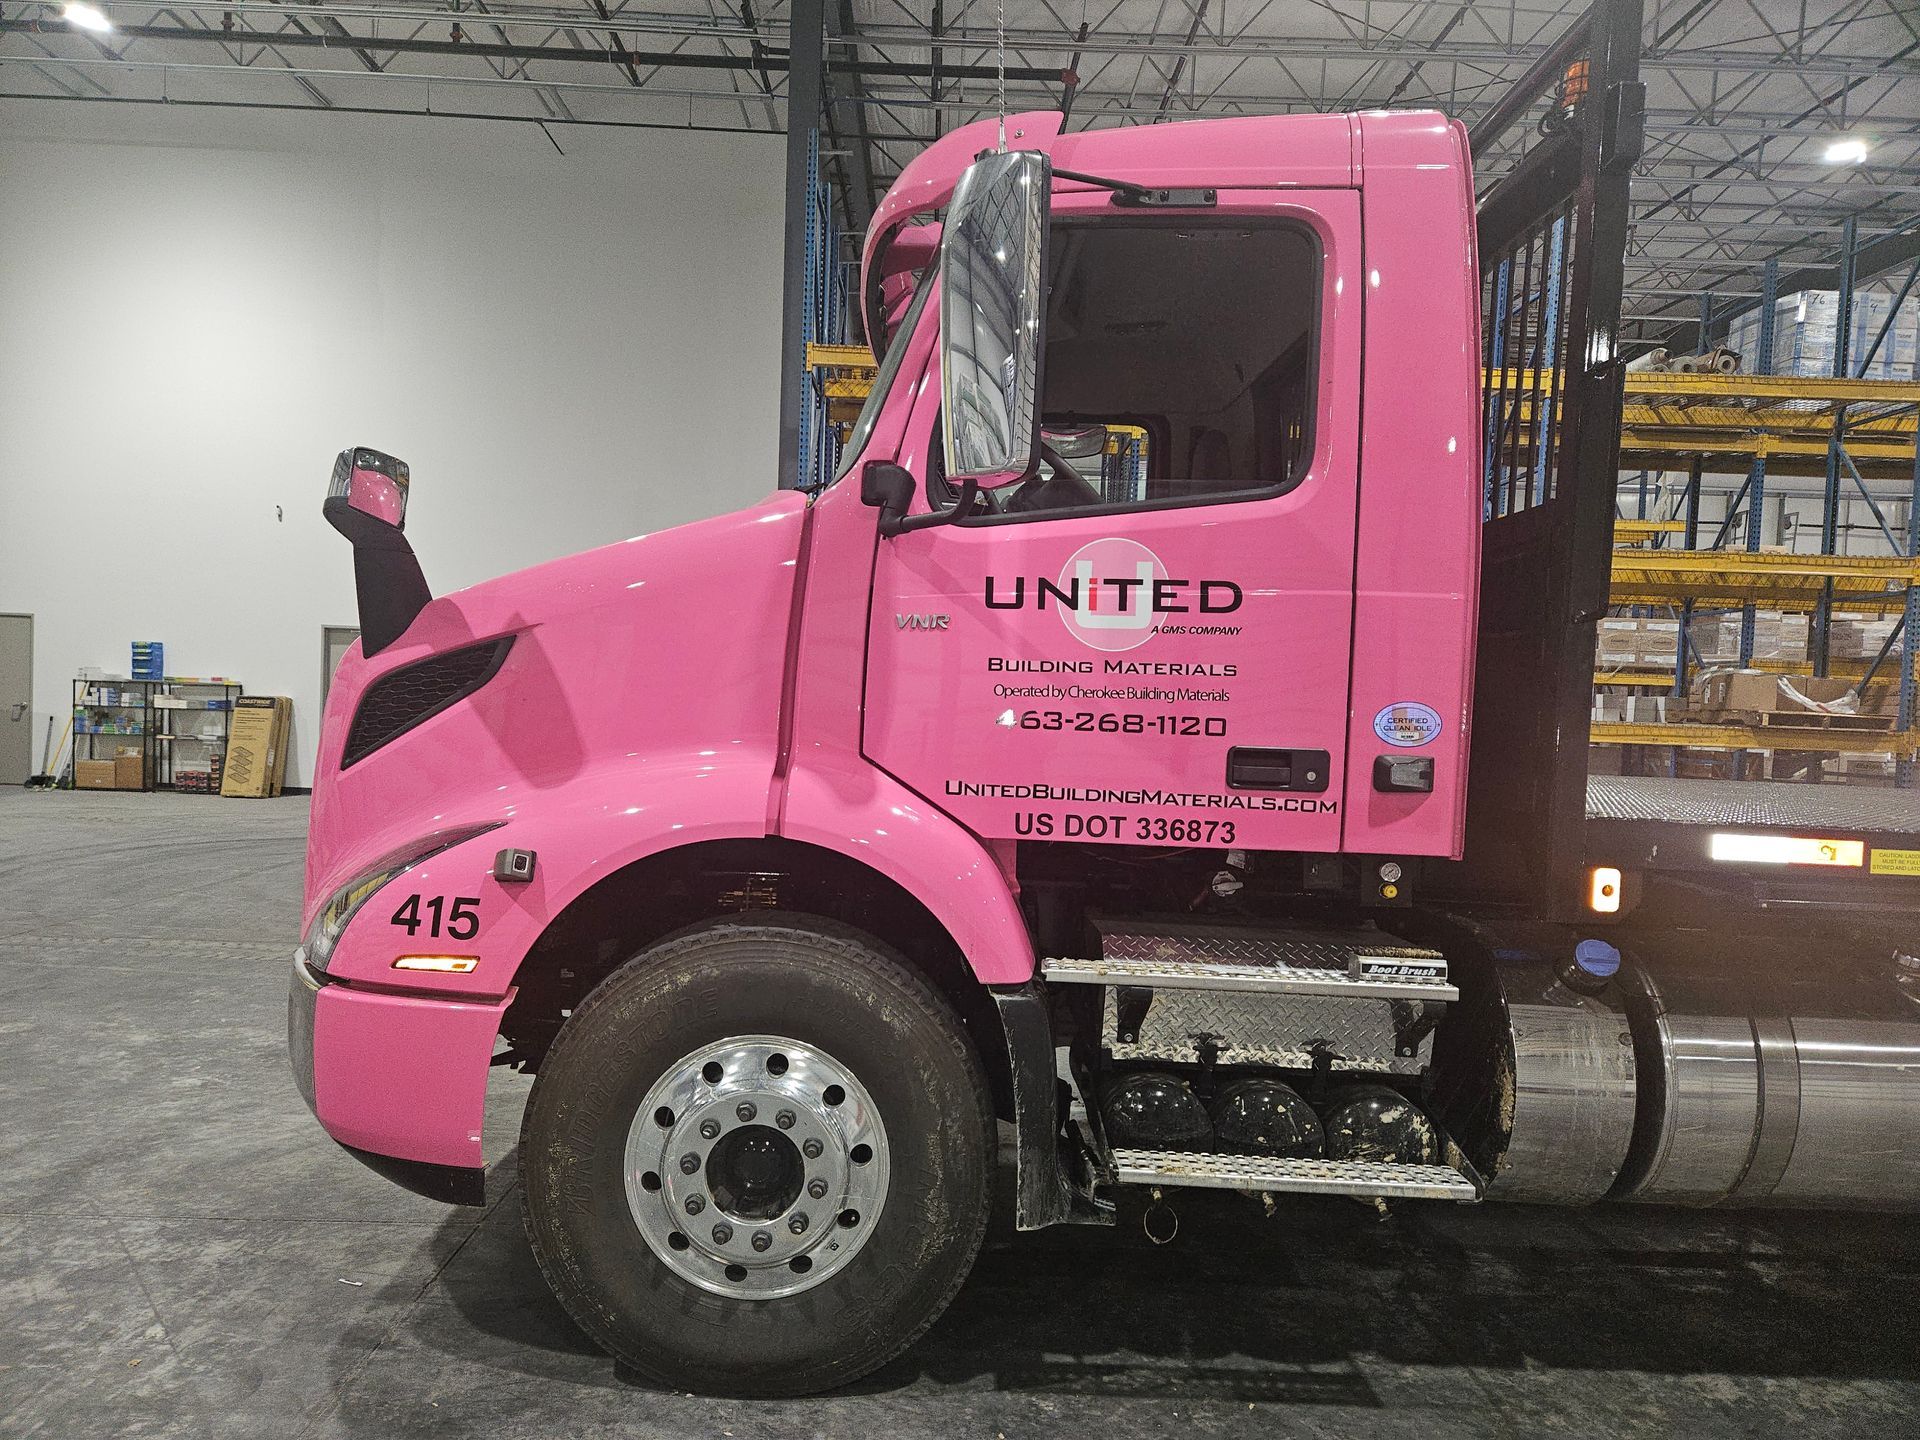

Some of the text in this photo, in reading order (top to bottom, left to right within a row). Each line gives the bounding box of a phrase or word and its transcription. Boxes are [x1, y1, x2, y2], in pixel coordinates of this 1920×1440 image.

[896, 613, 950, 630] VNR
[1150, 625, 1242, 636] A GMS COMPANY
[988, 657, 1237, 677] BUILDING MATERIALS
[993, 683, 1230, 703] Operated by Cherokee Building Materials
[1014, 812, 1236, 844] US DOT 336873
[391, 893, 481, 941] 415
[1369, 964, 1437, 977] Boot Brush
